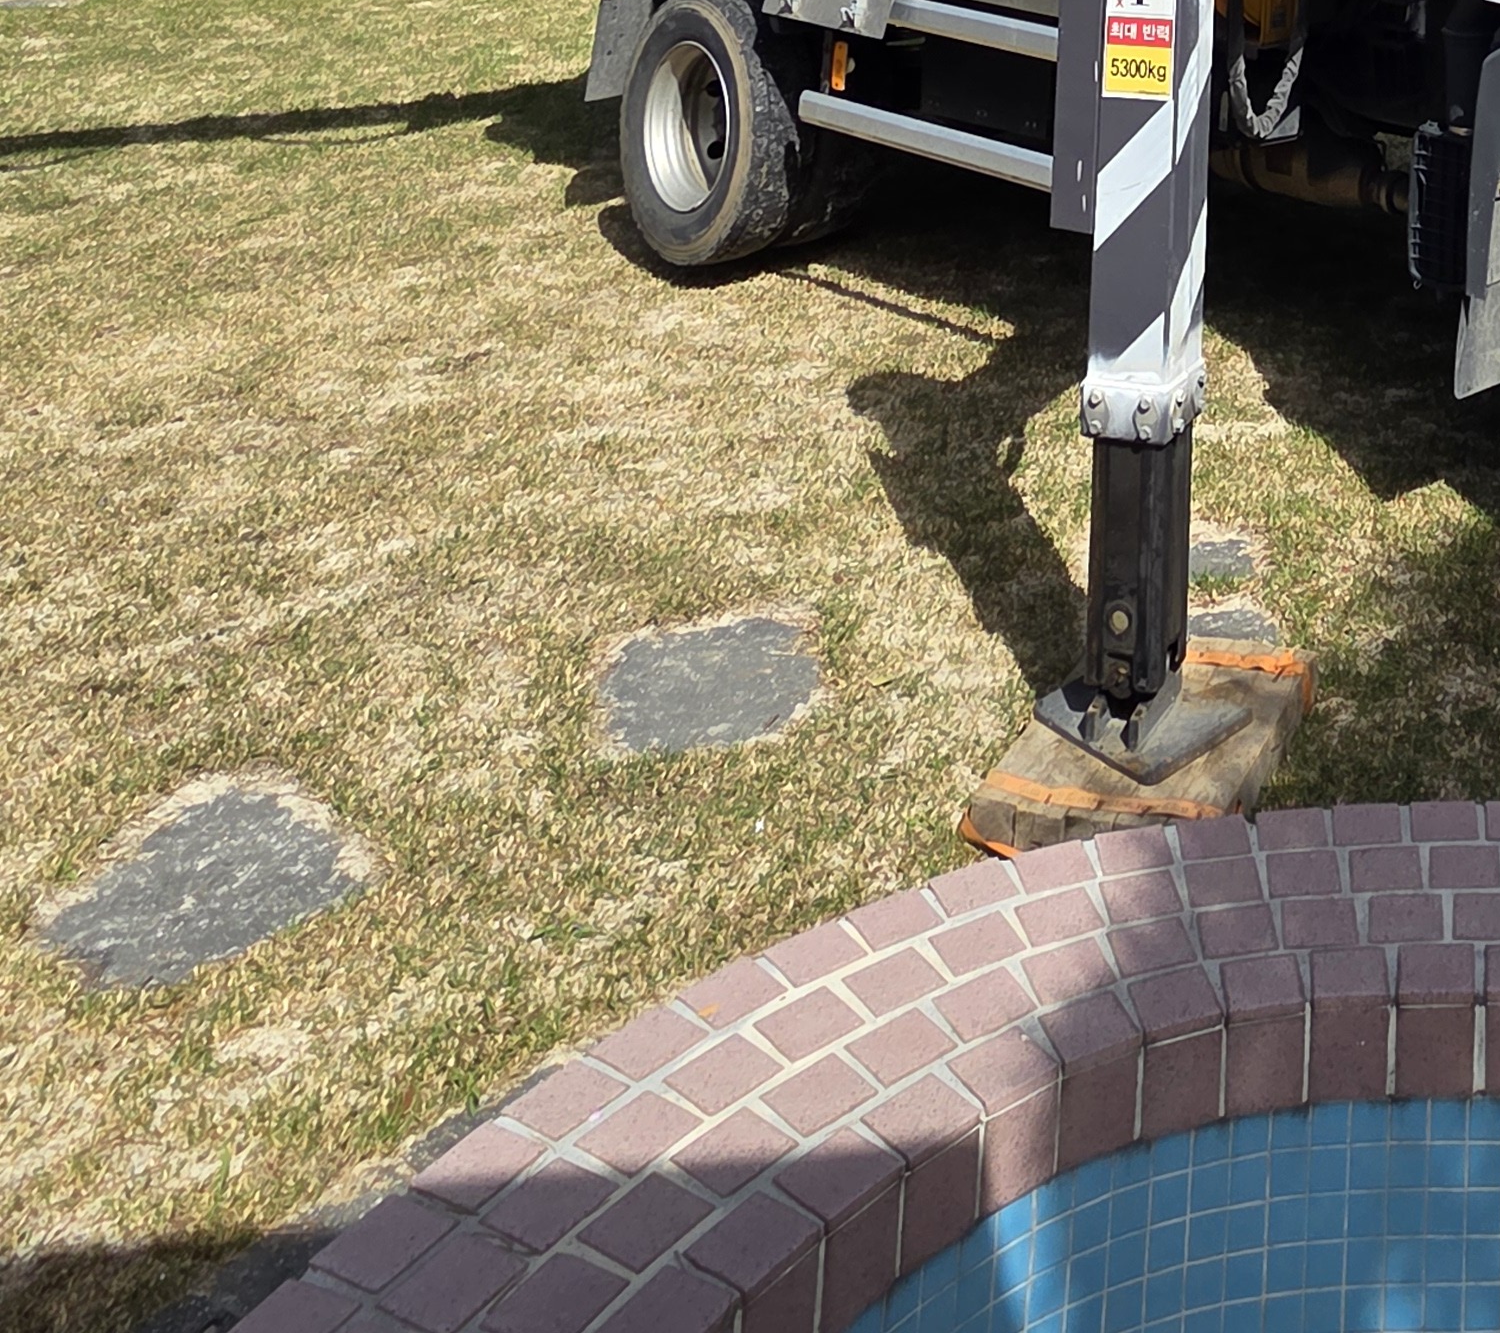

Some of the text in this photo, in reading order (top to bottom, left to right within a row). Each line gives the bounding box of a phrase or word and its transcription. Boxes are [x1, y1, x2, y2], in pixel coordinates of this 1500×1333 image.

[1109, 21, 1171, 42] 최대 반력
[1110, 57, 1168, 83] 5300kg
